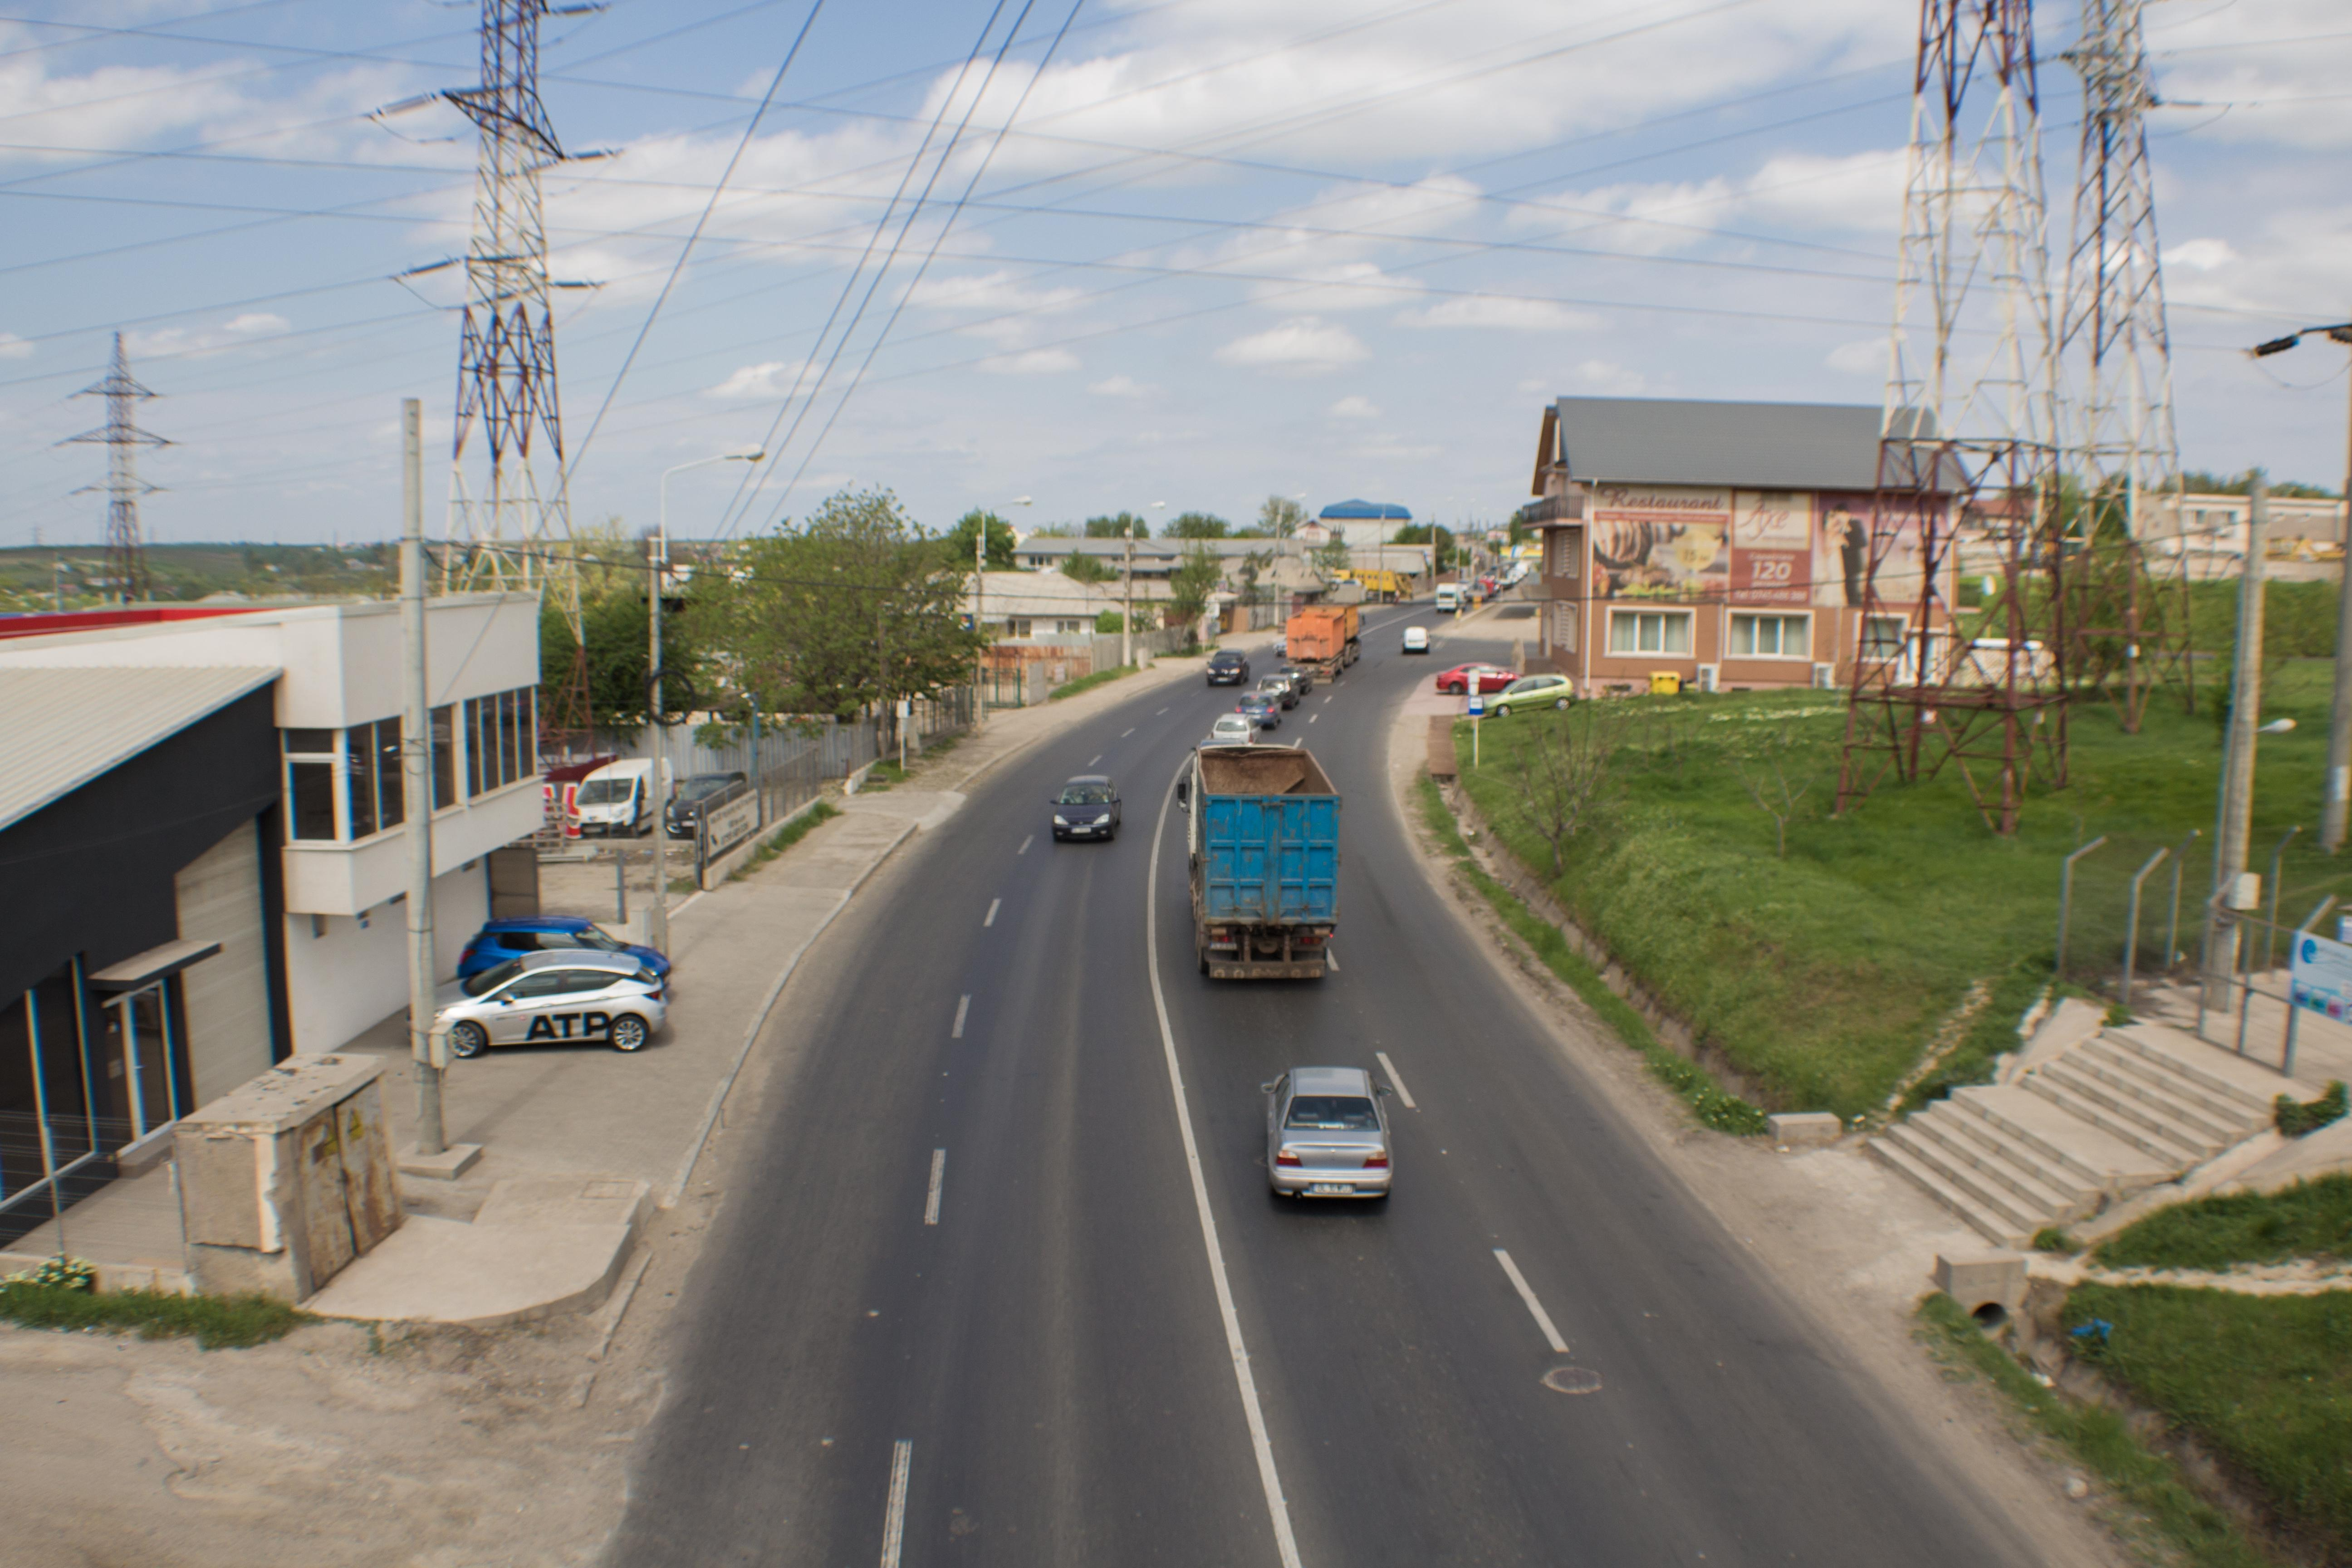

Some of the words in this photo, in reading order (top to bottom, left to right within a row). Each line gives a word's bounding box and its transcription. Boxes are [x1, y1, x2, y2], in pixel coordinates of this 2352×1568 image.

[1601, 487, 1723, 509] Restaurant
[1752, 561, 1792, 581] 120
[524, 1011, 612, 1041] ATP
